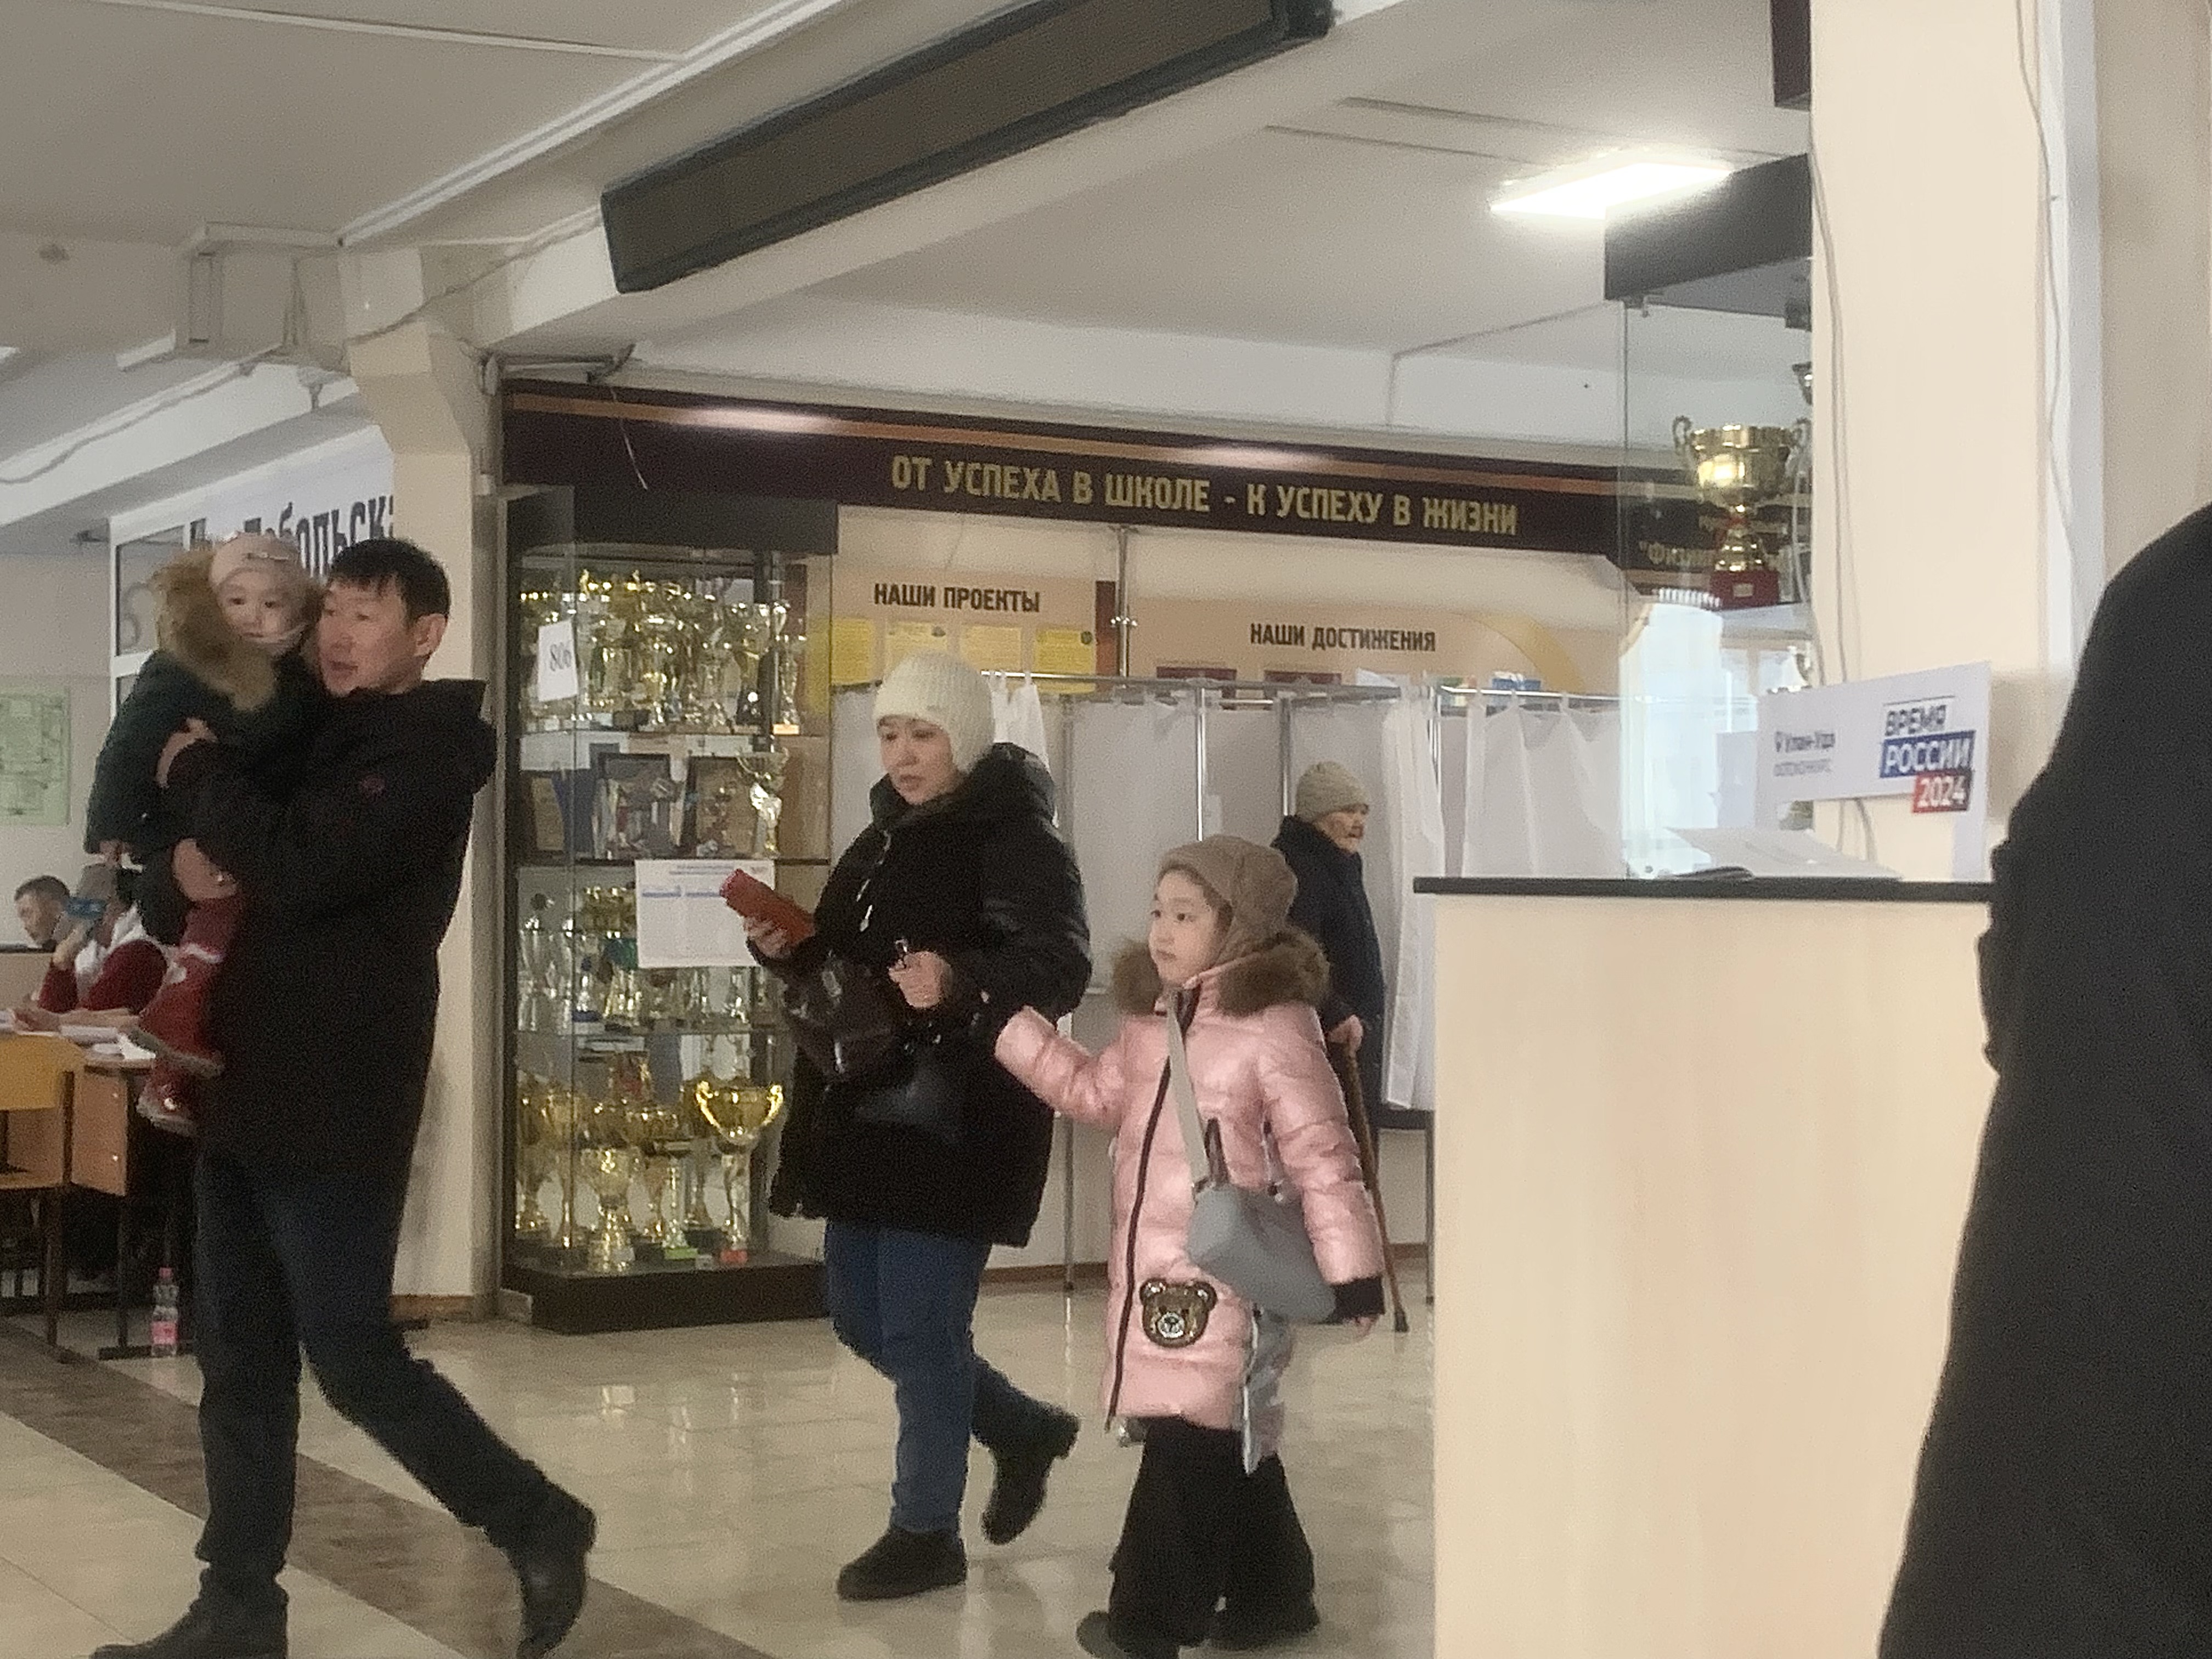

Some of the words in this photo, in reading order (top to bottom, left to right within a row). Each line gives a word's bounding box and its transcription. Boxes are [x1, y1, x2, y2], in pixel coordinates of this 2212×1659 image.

[891, 455, 932, 491] ОТ
[944, 460, 1062, 503] УСПЕХА
[1073, 471, 1093, 504] В
[1105, 473, 1210, 511] ШКОЛЕ
[1247, 484, 1266, 516] К
[1276, 485, 1383, 523] УСПЕХУ
[1393, 494, 1411, 526] В
[1423, 496, 1518, 535] ЖИЗНИ
[874, 583, 935, 607] НАШИ
[943, 587, 1040, 613] ПРОЕКТЫ
[1250, 623, 1305, 646] НАШИ
[1312, 627, 1436, 652] ДОСТИЖЕНИЯ
[1884, 704, 1946, 736] ВРЕМЯ
[1883, 737, 1972, 774] РОССИИ
[1917, 775, 1966, 808] 2024
